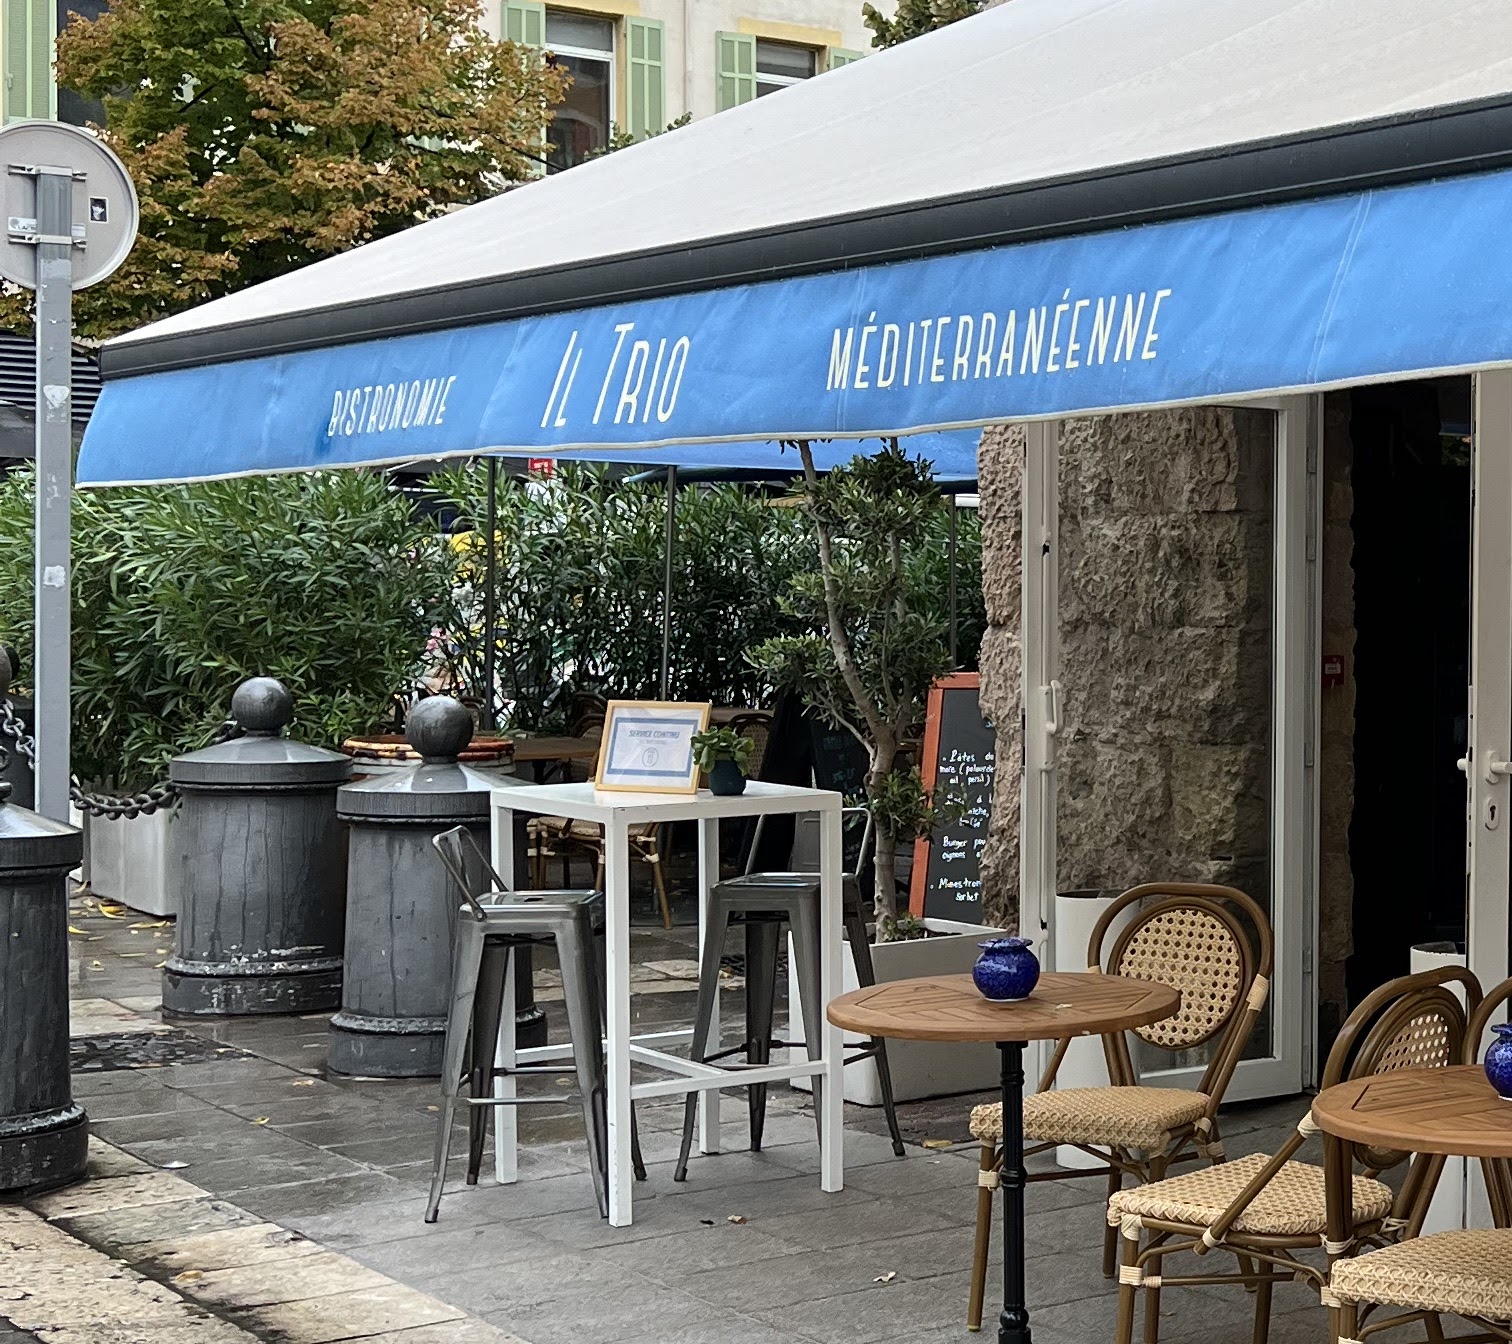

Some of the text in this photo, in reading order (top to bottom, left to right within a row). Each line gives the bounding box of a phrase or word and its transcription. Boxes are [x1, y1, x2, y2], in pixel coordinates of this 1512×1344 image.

[327, 287, 1172, 437] BISTRONOMIE IL TRIO MÉDITERRANÉENNE
